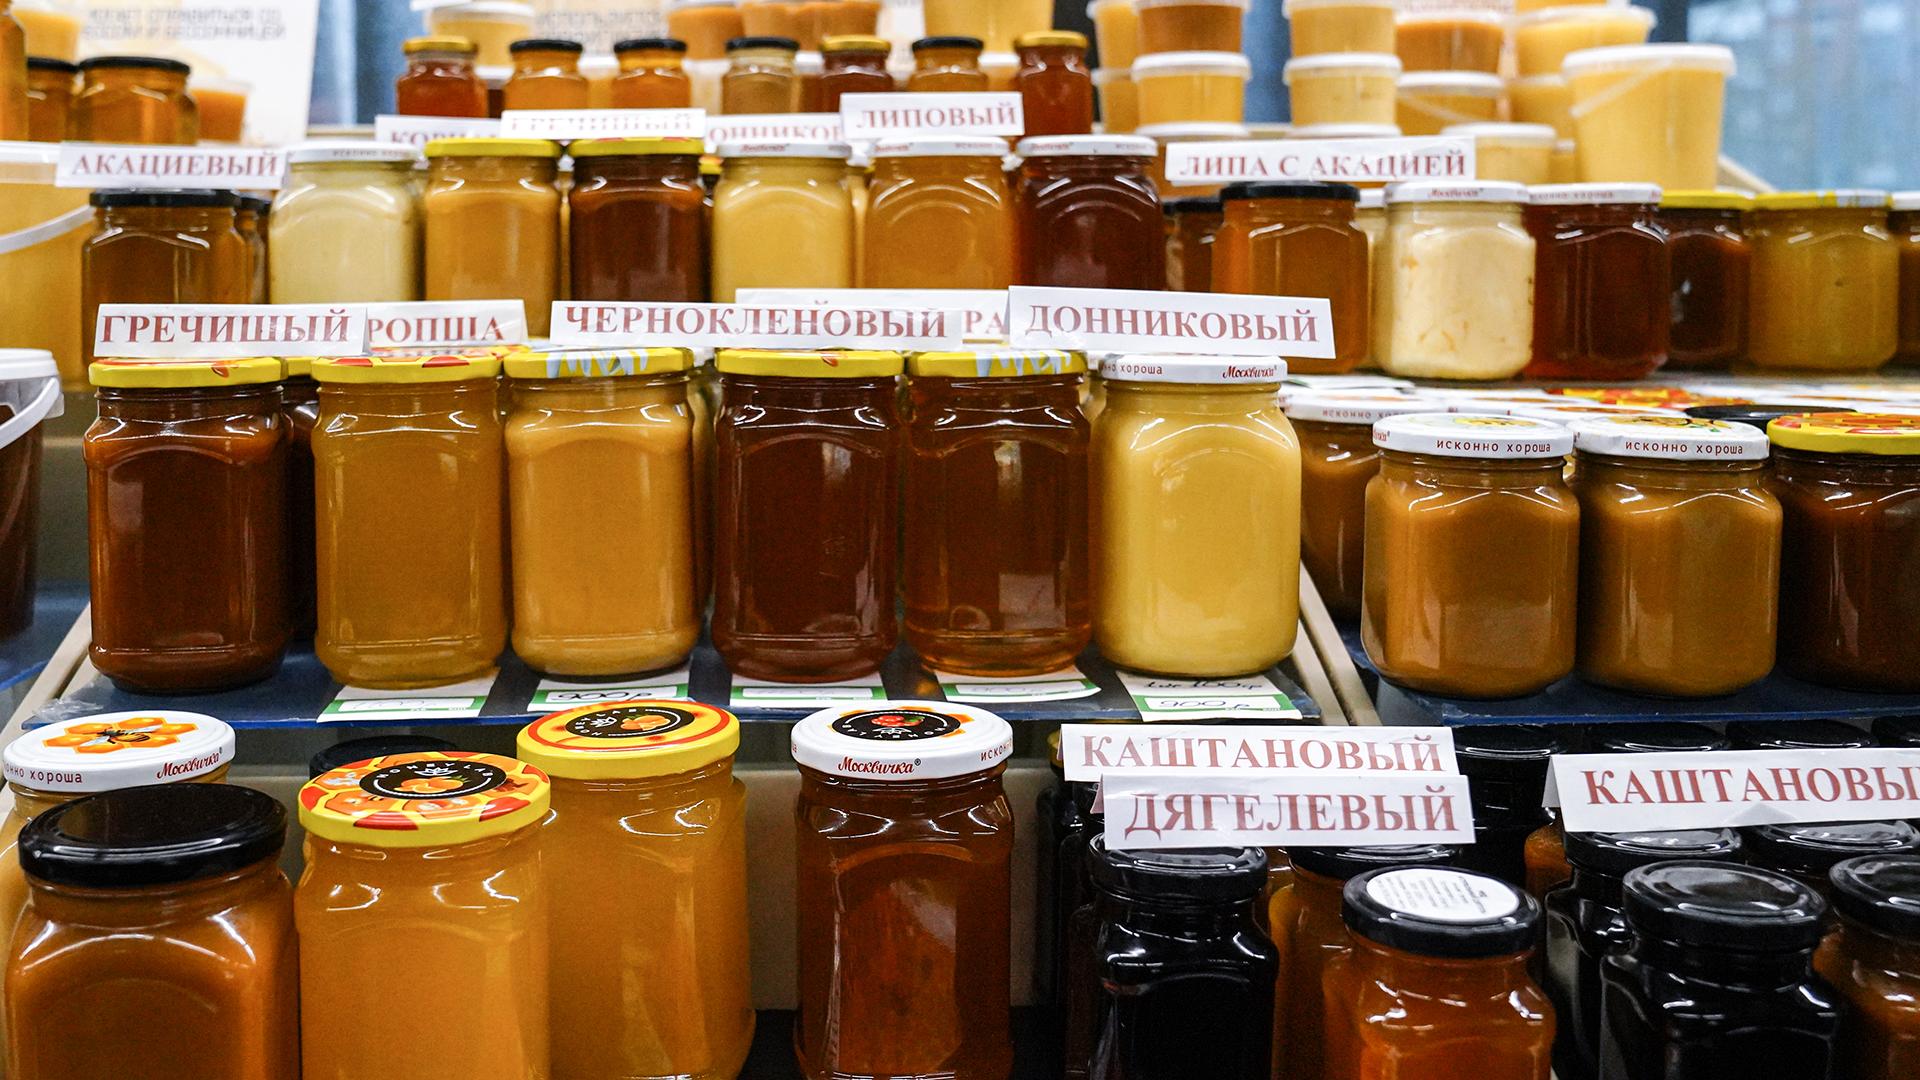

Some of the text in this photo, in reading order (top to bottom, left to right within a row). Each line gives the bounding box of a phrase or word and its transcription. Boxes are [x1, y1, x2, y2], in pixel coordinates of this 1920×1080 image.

[856, 101, 1017, 128] ЛИПОВЫЙ
[72, 150, 277, 178] АКАЦИЕВЫЙ
[1179, 149, 1466, 179] ЛИПА С АКАЦИЕЙ
[102, 308, 351, 343] ГРЕЧИШЫЙ
[565, 305, 948, 338] ЧЕРНОКЛЕНОВЫЙ
[1025, 304, 1320, 342] ДОННИКОВЫЙ
[1120, 364, 1163, 377] хороша
[1436, 439, 1551, 455] исконно хороша
[1625, 441, 1743, 456] исконно хороша
[157, 753, 219, 779] Москвичка
[838, 756, 915, 774] Москвичка
[1081, 734, 1445, 773] КАШТАНОВЫЙ
[30, 770, 83, 785] хороша
[1580, 766, 1920, 805] КАШТАНОВЫ
[1124, 784, 1460, 841] ДЯГЕЛЕВЫЙ
